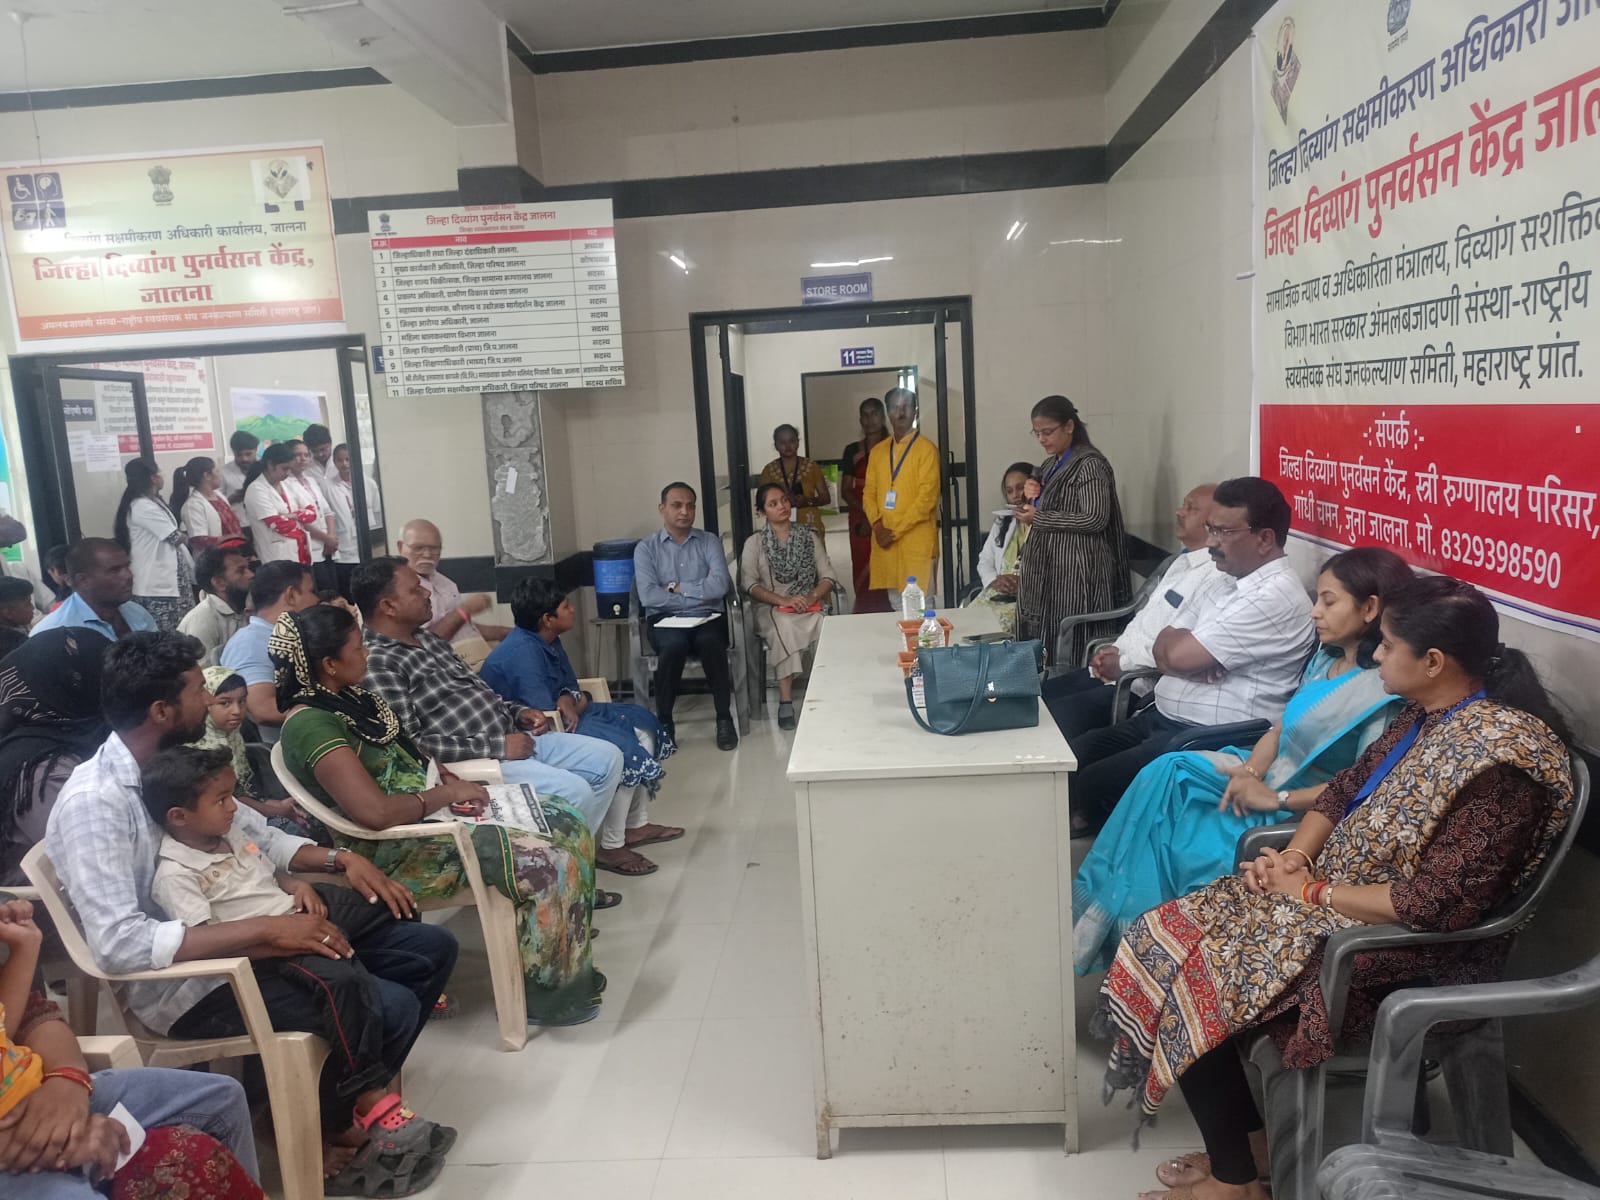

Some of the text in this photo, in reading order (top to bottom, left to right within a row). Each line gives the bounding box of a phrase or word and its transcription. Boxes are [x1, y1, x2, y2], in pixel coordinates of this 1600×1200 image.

[1268, 146, 1297, 191] जिल्हा
[1299, 114, 1340, 173] दिव्यांग
[1342, 58, 1436, 147] सक्षमीकरण
[1264, 207, 1301, 259] जिल्हा
[1304, 170, 1361, 243] दिव्यांग
[1365, 131, 1464, 238] पुनर्वसन
[1468, 98, 1527, 177] केंद्र
[426, 215, 449, 225] जिल्हा
[452, 213, 478, 225] दिव्यांग
[481, 212, 512, 225] पुनर्वसन
[530, 211, 556, 220] जालना
[167, 225, 213, 240] अधिकारी
[216, 221, 268, 236] कार्यालय,
[270, 221, 307, 233] जालना
[33, 257, 99, 280] जिल्हा
[182, 245, 262, 278] पुनर्वसन
[268, 242, 315, 267] केंद्र,
[1266, 279, 1300, 313] सामाजिक
[1301, 277, 1320, 303] न्याय
[1322, 275, 1331, 299] व
[1332, 252, 1392, 297] अधिकारिता
[1395, 240, 1451, 281] मंत्रालय,
[1455, 215, 1516, 270] दिव्यांग
[380, 266, 385, 274] 2
[382, 280, 387, 288] 3
[806, 283, 868, 298] STORE ROOM
[139, 285, 214, 304] जालना
[383, 294, 389, 302] 4
[1284, 260, 1593, 350] विभाग भारत सरकार अंमलबजावणी संस्था-राष्ट्रीय
[386, 321, 392, 329] 6
[388, 349, 394, 357] 8
[843, 350, 855, 365] 11
[390, 362, 396, 370] 9
[1285, 357, 1325, 389] स्वयंसेवक
[1326, 356, 1343, 387] संघ
[1344, 357, 1407, 386] जनकल्याण
[1410, 341, 1459, 389] समिती,
[1463, 345, 1534, 390] महाराष्ट्र
[390, 376, 399, 384] 10
[392, 389, 399, 397] 11
[1374, 409, 1411, 449] संपर्क
[1278, 446, 1303, 481] जिल्हा
[1304, 449, 1338, 487] दिव्यांग
[1340, 455, 1381, 498] पुनर्वसन
[1383, 458, 1412, 505] केंद्र,
[1415, 462, 1440, 505] स्त्री
[1442, 475, 1522, 519] रुग्णालय
[1293, 489, 1315, 523] गांधी
[1316, 499, 1343, 535] चमन,
[1344, 505, 1367, 544] जुना
[1416, 513, 1437, 556] मो.
[1441, 528, 1562, 589] 8329398590
